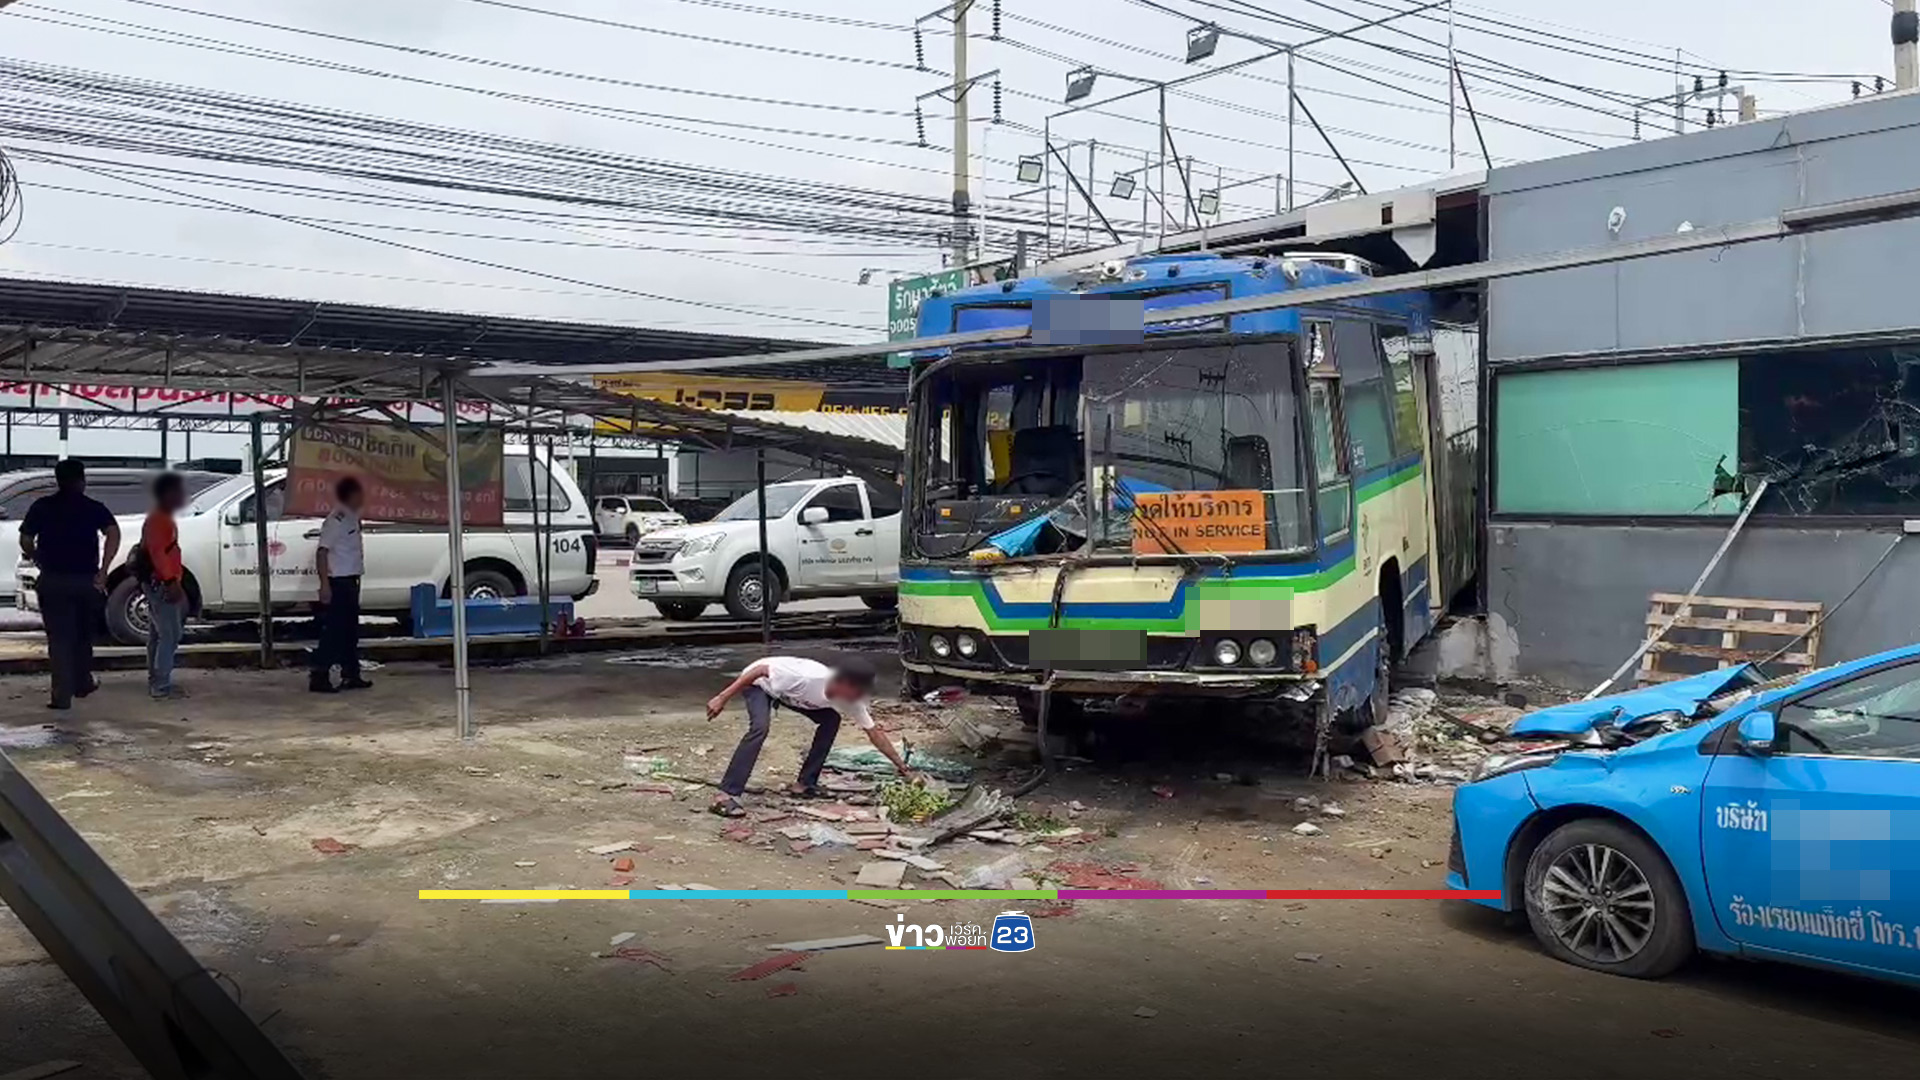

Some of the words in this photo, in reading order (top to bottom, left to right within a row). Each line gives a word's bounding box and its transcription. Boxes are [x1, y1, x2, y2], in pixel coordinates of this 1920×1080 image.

[1174, 526, 1189, 538] IN
[1196, 524, 1261, 538] SERVICE
[552, 538, 581, 553] 104
[1716, 800, 1768, 832] บริษัท
